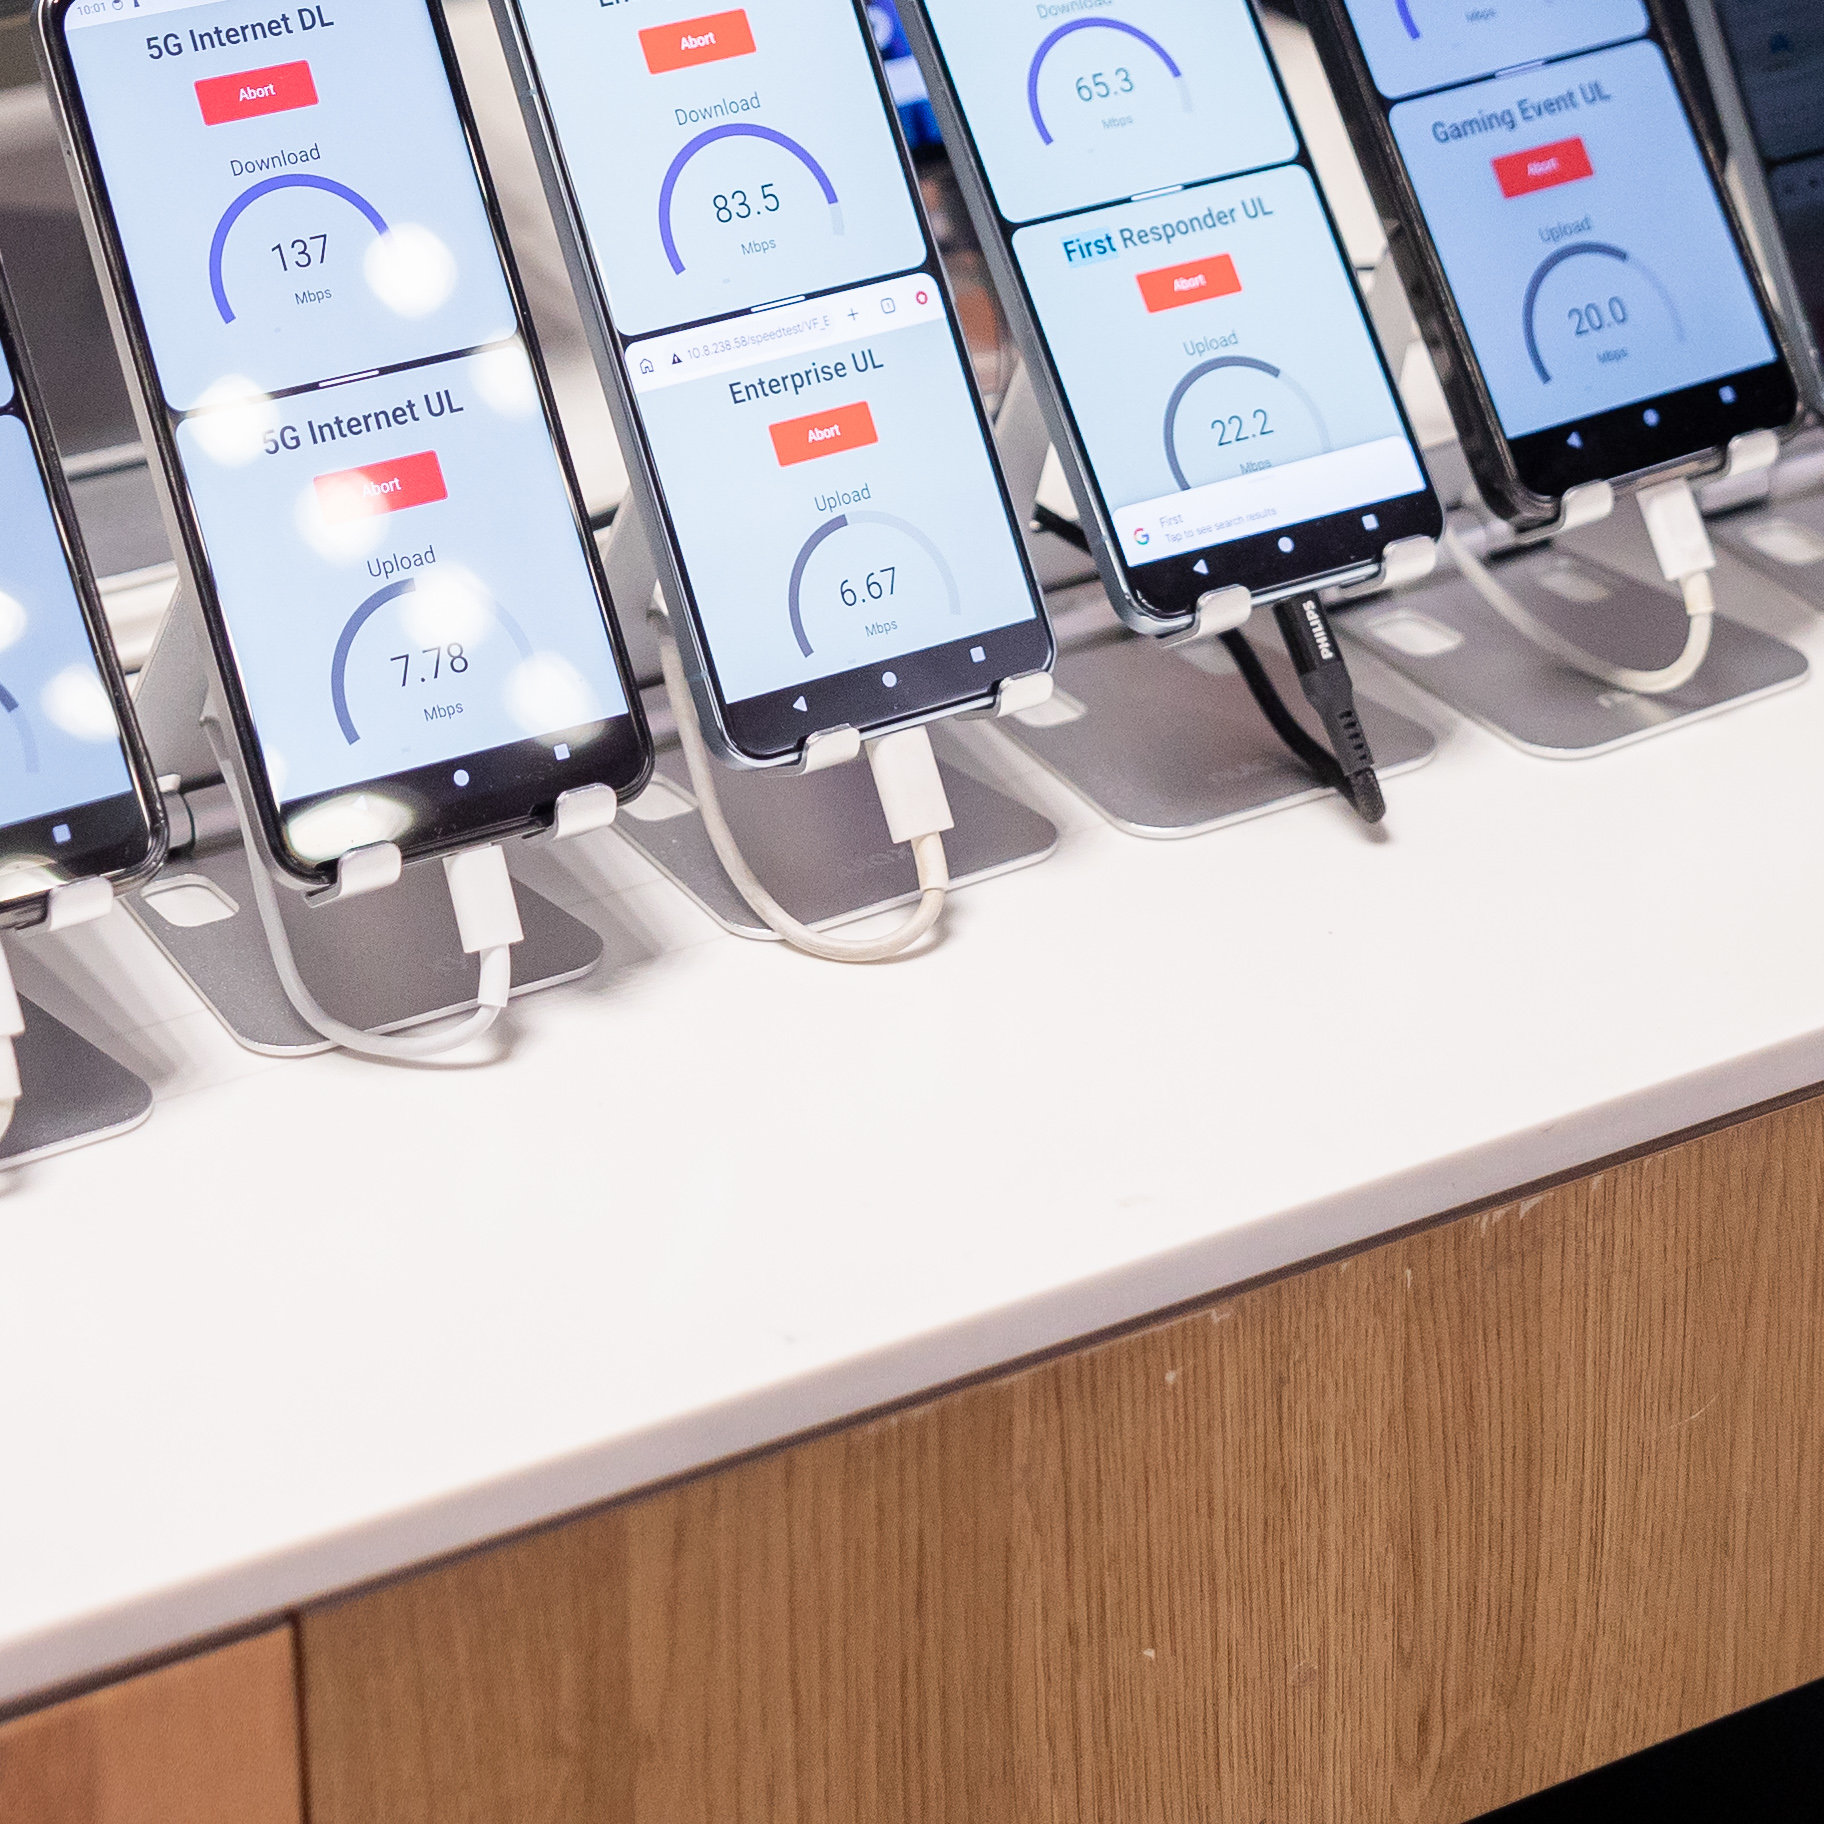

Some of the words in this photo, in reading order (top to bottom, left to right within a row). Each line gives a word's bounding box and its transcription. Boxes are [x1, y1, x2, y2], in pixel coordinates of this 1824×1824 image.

[76, 1, 107, 16] 10:01
[145, 32, 182, 59] 5G
[189, 12, 292, 51] Internet
[298, 4, 333, 31] DL
[680, 30, 714, 50] Abort
[238, 81, 274, 101] Abort
[1075, 67, 1133, 101] 65.3
[674, 91, 759, 125] Download
[1101, 113, 1132, 129] Mbps
[1431, 110, 1514, 143] Gaming
[1518, 94, 1574, 122] Event
[1579, 79, 1609, 103] UL
[229, 142, 320, 176] Download
[712, 183, 779, 223] 83.5
[741, 236, 775, 255] Mbps
[1062, 232, 1116, 262] First
[1119, 207, 1235, 248] Responder
[1241, 195, 1272, 218] UL
[1537, 215, 1591, 242] Upload
[270, 232, 327, 271] 137
[294, 286, 331, 306] Mbps
[1173, 273, 1205, 291] Abort
[1567, 294, 1627, 335] 20.0
[1182, 330, 1237, 356] Upload
[727, 361, 846, 403] Enterprise
[851, 347, 883, 372] UL
[261, 424, 300, 454] 5G
[306, 399, 419, 443] Internet
[422, 388, 462, 417] UL
[807, 422, 840, 442] Abort
[1210, 407, 1273, 445] 22.2
[361, 475, 401, 497] Abort
[813, 483, 870, 512] Upload
[366, 543, 435, 580] Upload
[838, 566, 896, 606] 6.67
[865, 617, 896, 636] Mbps
[1303, 599, 1332, 659] PHILIPS
[389, 641, 468, 688] 7.78
[423, 700, 463, 722] Mbps
